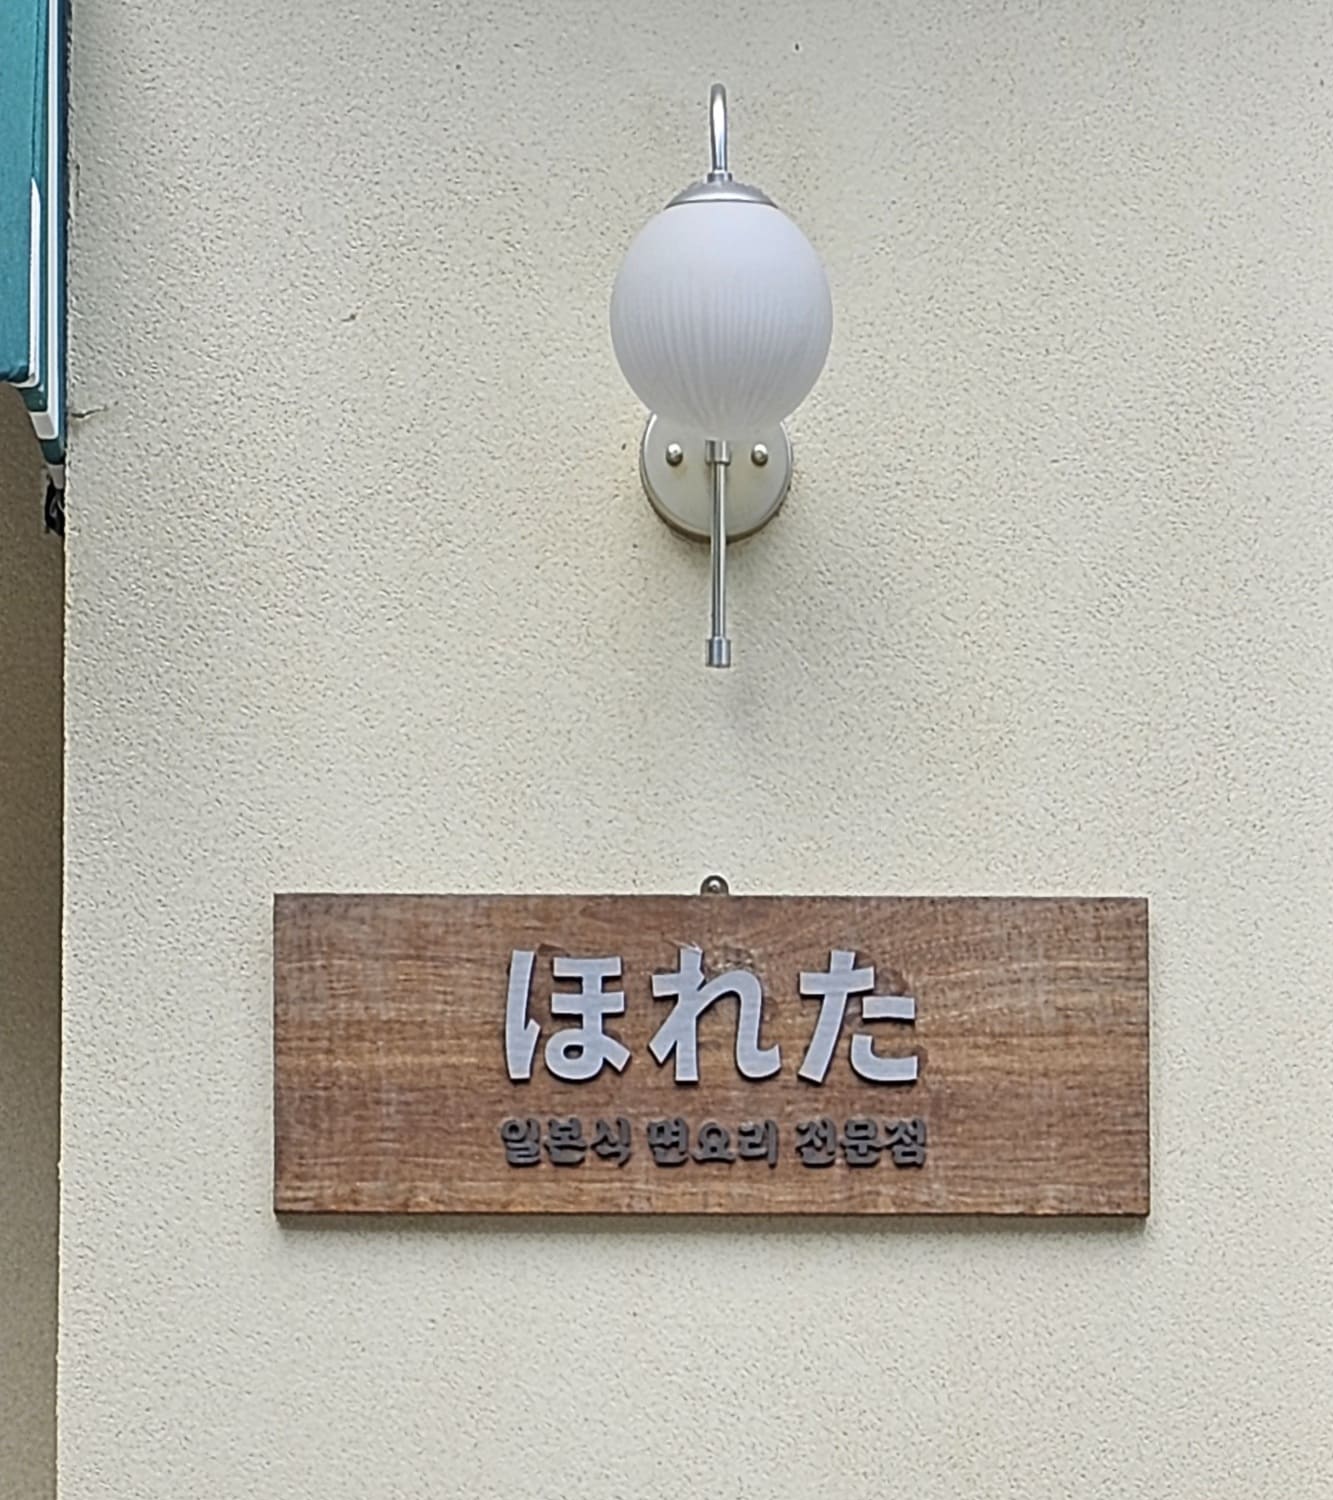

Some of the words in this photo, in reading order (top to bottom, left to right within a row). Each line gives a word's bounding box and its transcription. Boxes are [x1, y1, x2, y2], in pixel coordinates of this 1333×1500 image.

[505, 949, 919, 1085] ほれた
[502, 1117, 632, 1167] 일본식
[647, 1117, 779, 1167] 면요리
[797, 1117, 928, 1167] 전문점
